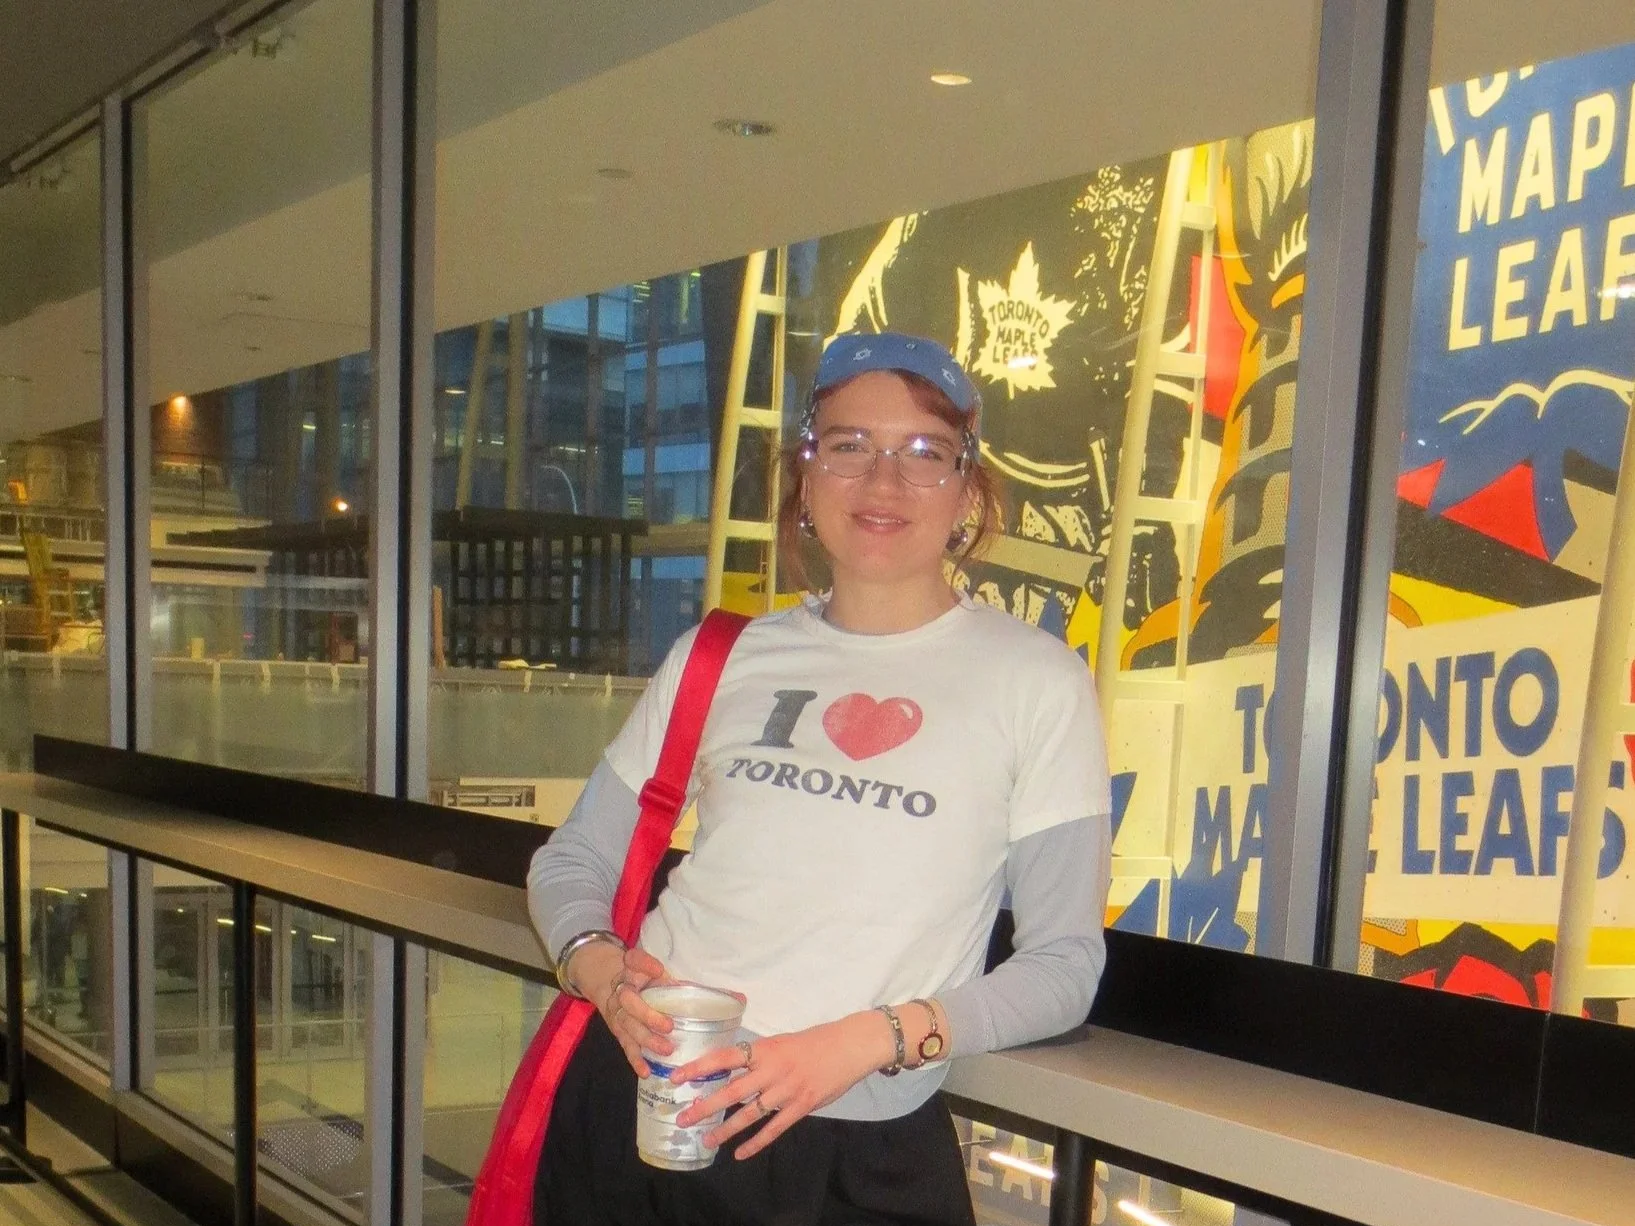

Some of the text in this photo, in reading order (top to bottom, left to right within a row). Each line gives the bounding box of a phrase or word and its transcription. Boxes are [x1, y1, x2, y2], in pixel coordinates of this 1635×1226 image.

[989, 300, 1050, 339] TORONTO
[996, 326, 1036, 349] MAPLE
[751, 690, 818, 748] I
[1235, 646, 1559, 774] TNTO
[726, 757, 937, 818] TORONTO
